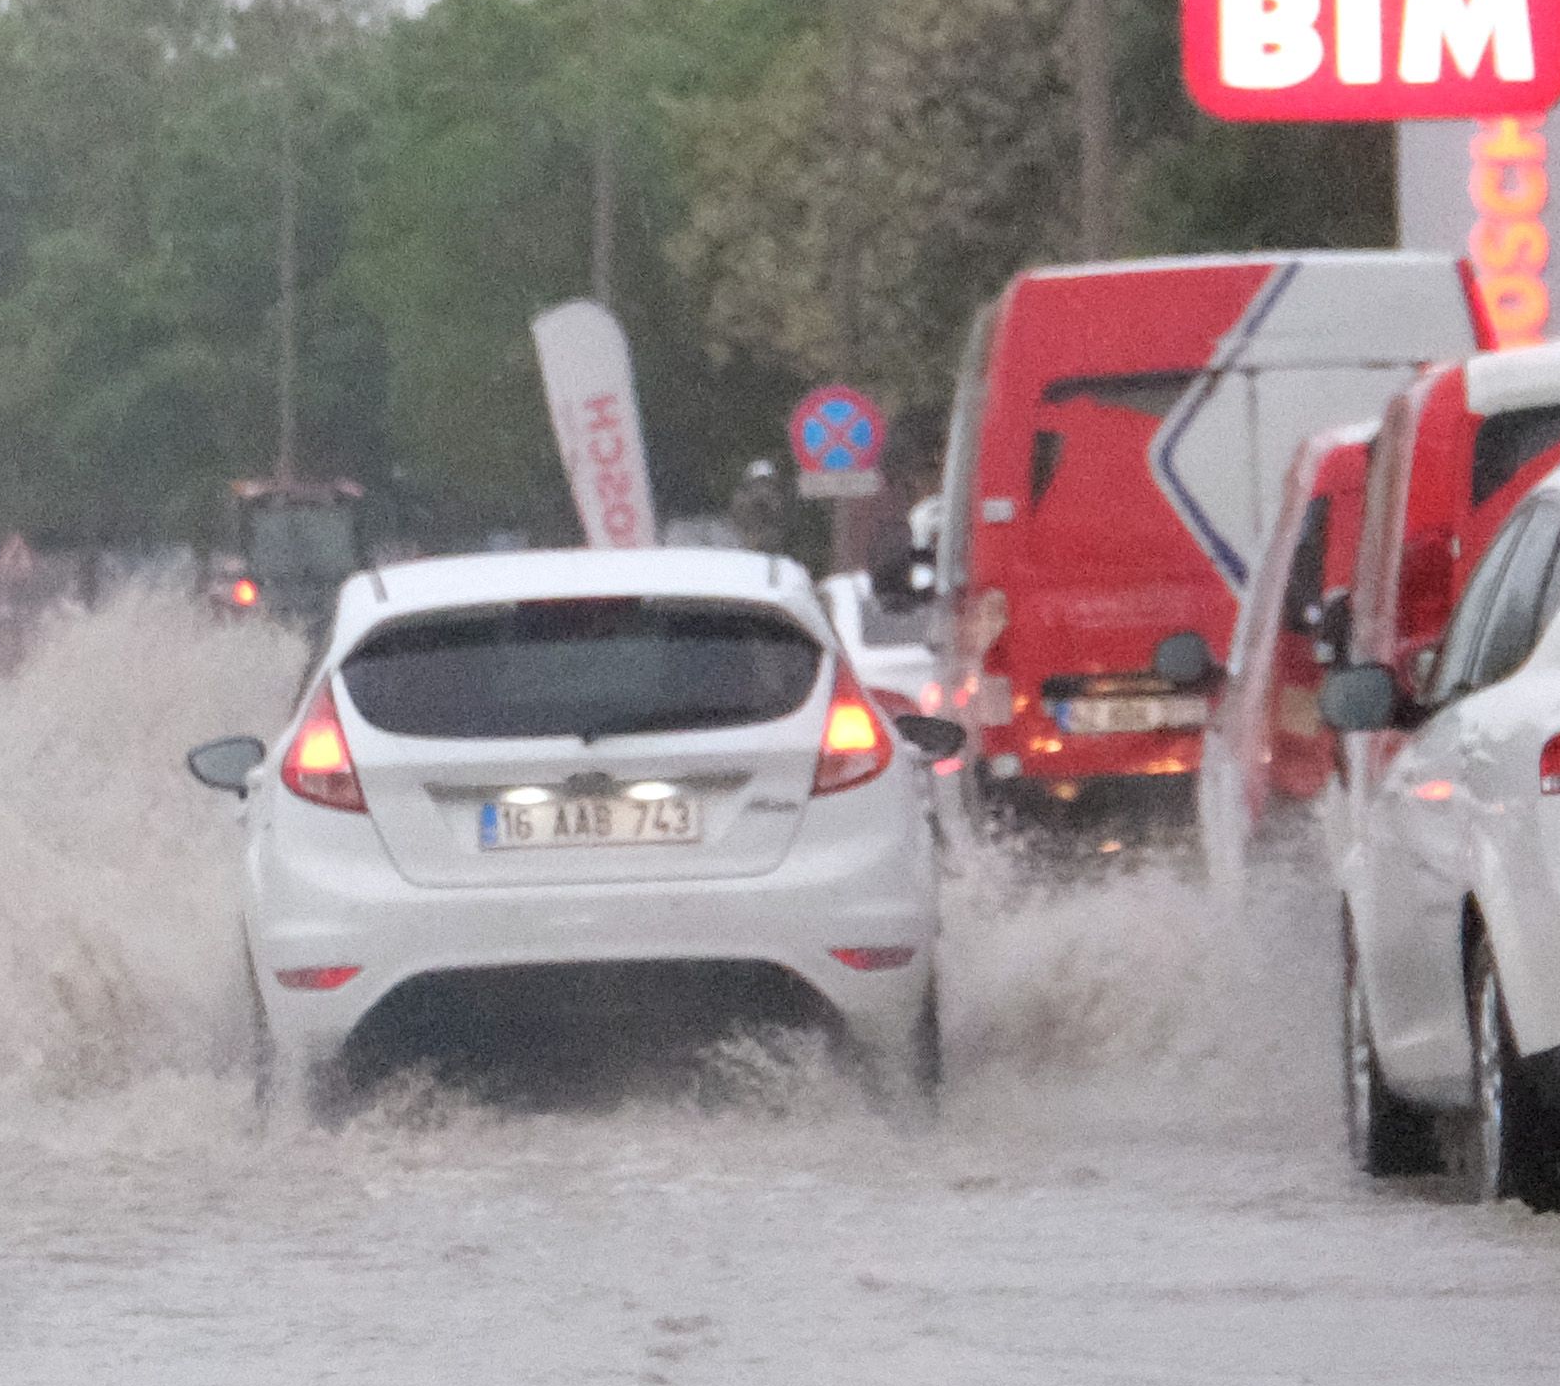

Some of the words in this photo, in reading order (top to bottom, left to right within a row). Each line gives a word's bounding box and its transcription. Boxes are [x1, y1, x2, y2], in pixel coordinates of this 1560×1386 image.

[583, 391, 638, 547] OSCH
[499, 804, 533, 840] 16
[553, 799, 612, 838] AAB
[634, 798, 691, 835] 743
